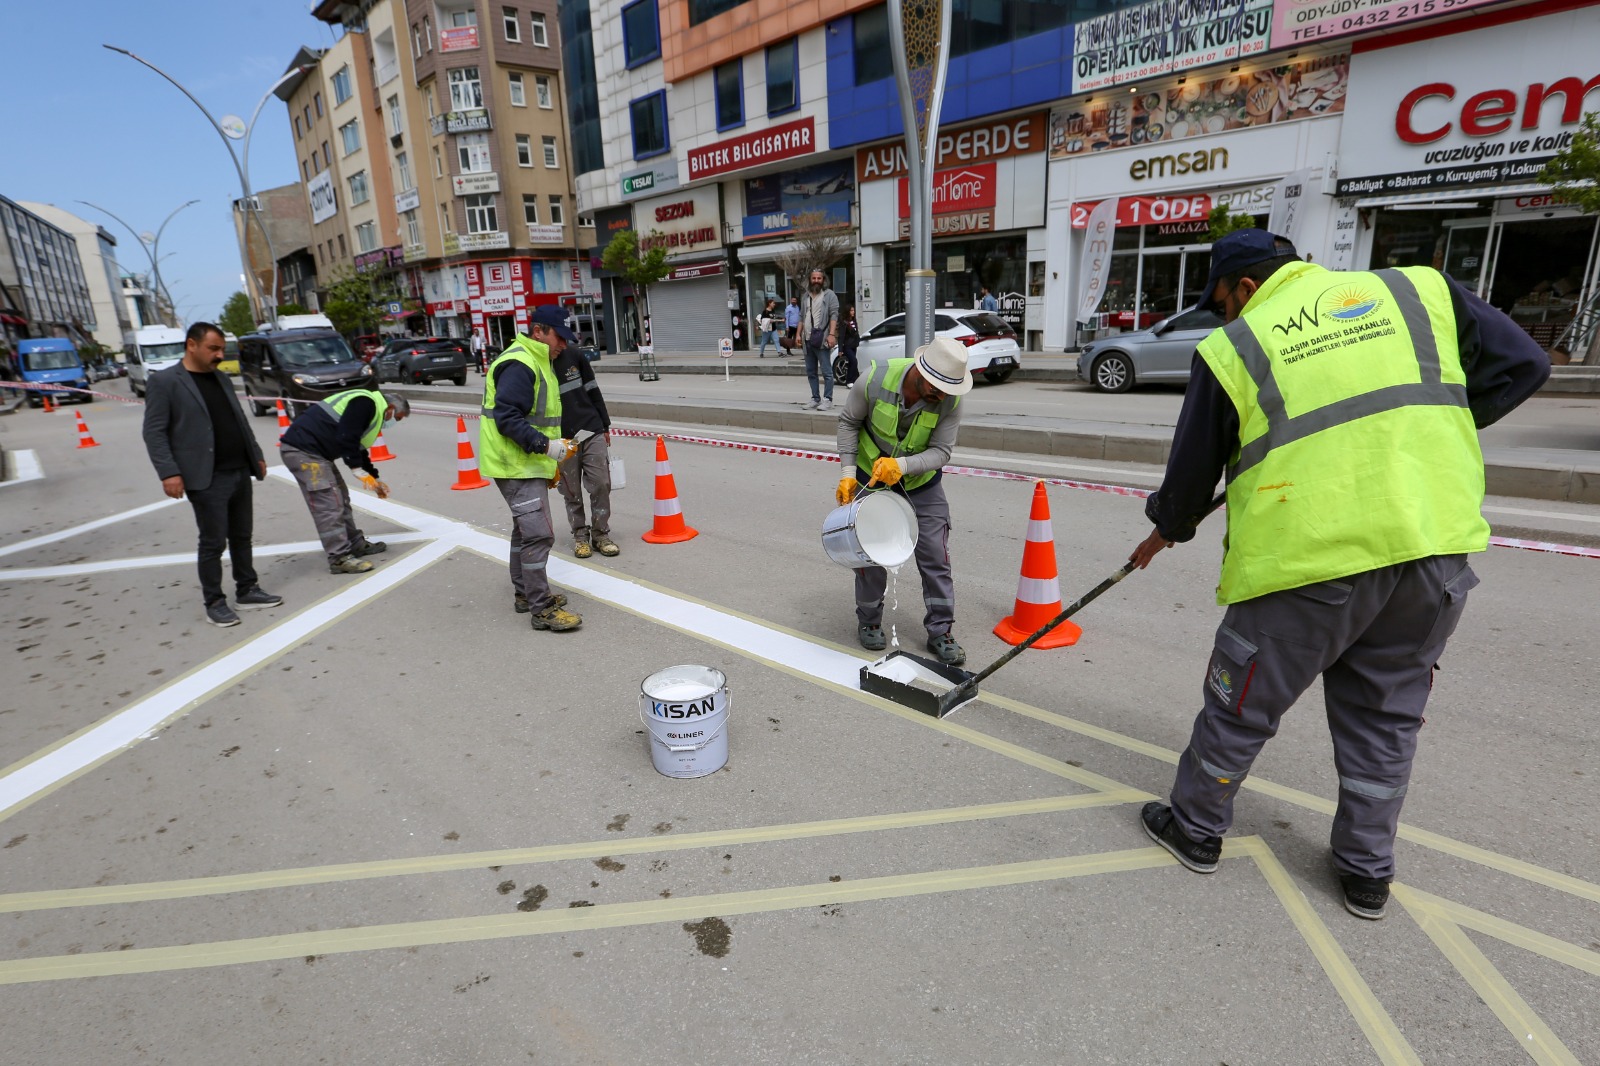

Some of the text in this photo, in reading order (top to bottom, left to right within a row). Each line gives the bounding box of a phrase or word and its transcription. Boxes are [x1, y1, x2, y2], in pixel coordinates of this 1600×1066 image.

[1291, 24, 1335, 41] TEL:
[1341, 10, 1390, 30] 0432
[1396, 1, 1435, 19] 215
[1125, 71, 1137, 80] 212
[1181, 57, 1194, 67] 150
[1196, 55, 1205, 64] 41
[1207, 52, 1217, 61] 07
[691, 127, 810, 173] BİLTEK BİLGİSAYAR
[864, 119, 1031, 178] AYN PERDE
[1424, 131, 1573, 164] ucuzluğun ve kalit
[1129, 146, 1229, 181] emsan
[1348, 162, 1546, 193] Bakliyat Baharat Kuruyemiş Lokum
[655, 200, 695, 223] SEZON
[763, 212, 789, 230] MNG
[1072, 206, 1088, 226] 2
[1130, 195, 1206, 223] 1 ÖDE
[1158, 221, 1210, 235] MAĞAZA
[484, 297, 510, 305] ECZANE
[1280, 317, 1392, 356] ULAŞIM DAİRESİ BAŞKANLIĞI
[1284, 352, 1306, 366] TRAFİK
[1306, 341, 1342, 358] HİZMETLERİ
[1342, 337, 1359, 348] ŞUBE
[678, 730, 704, 739] LINER
